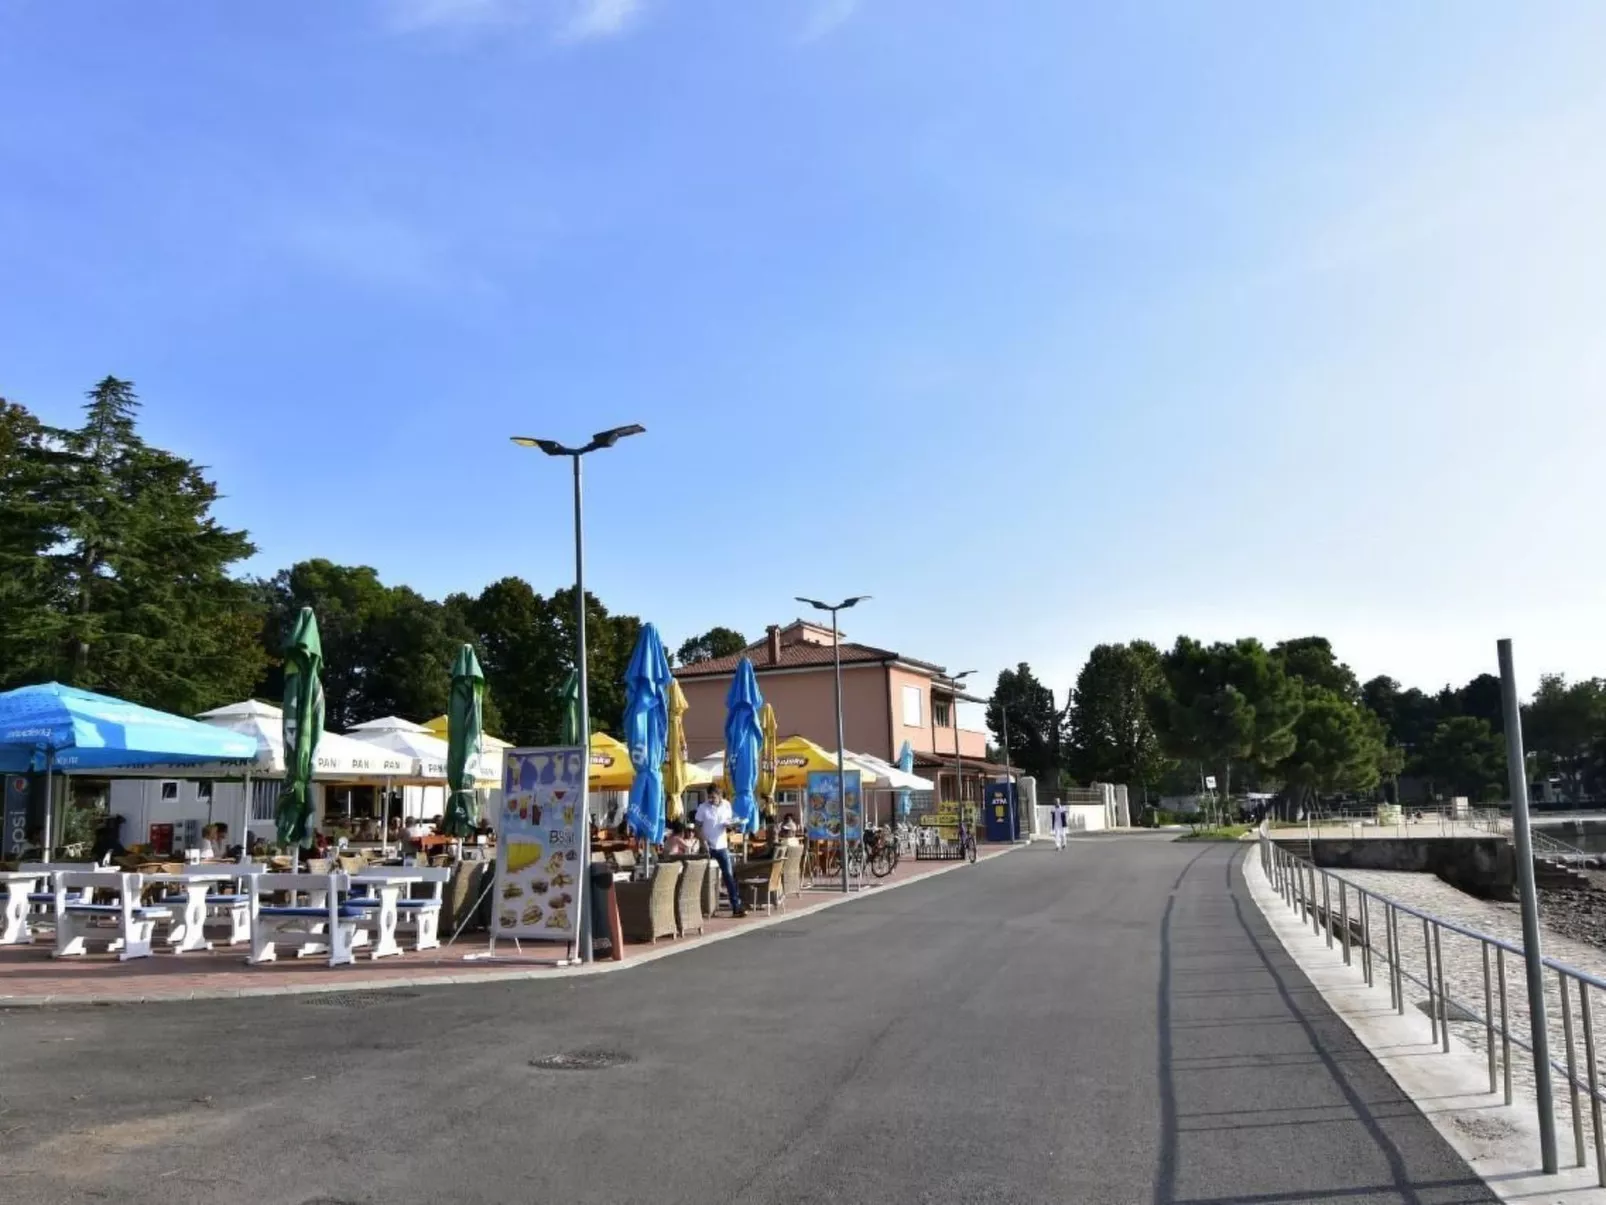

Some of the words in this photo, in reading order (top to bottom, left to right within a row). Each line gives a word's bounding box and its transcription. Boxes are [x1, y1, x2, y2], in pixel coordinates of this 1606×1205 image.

[318, 757, 337, 768] PAN
[352, 759, 370, 770] PAN
[383, 760, 401, 770] PAN
[10, 810, 27, 854] epsi
